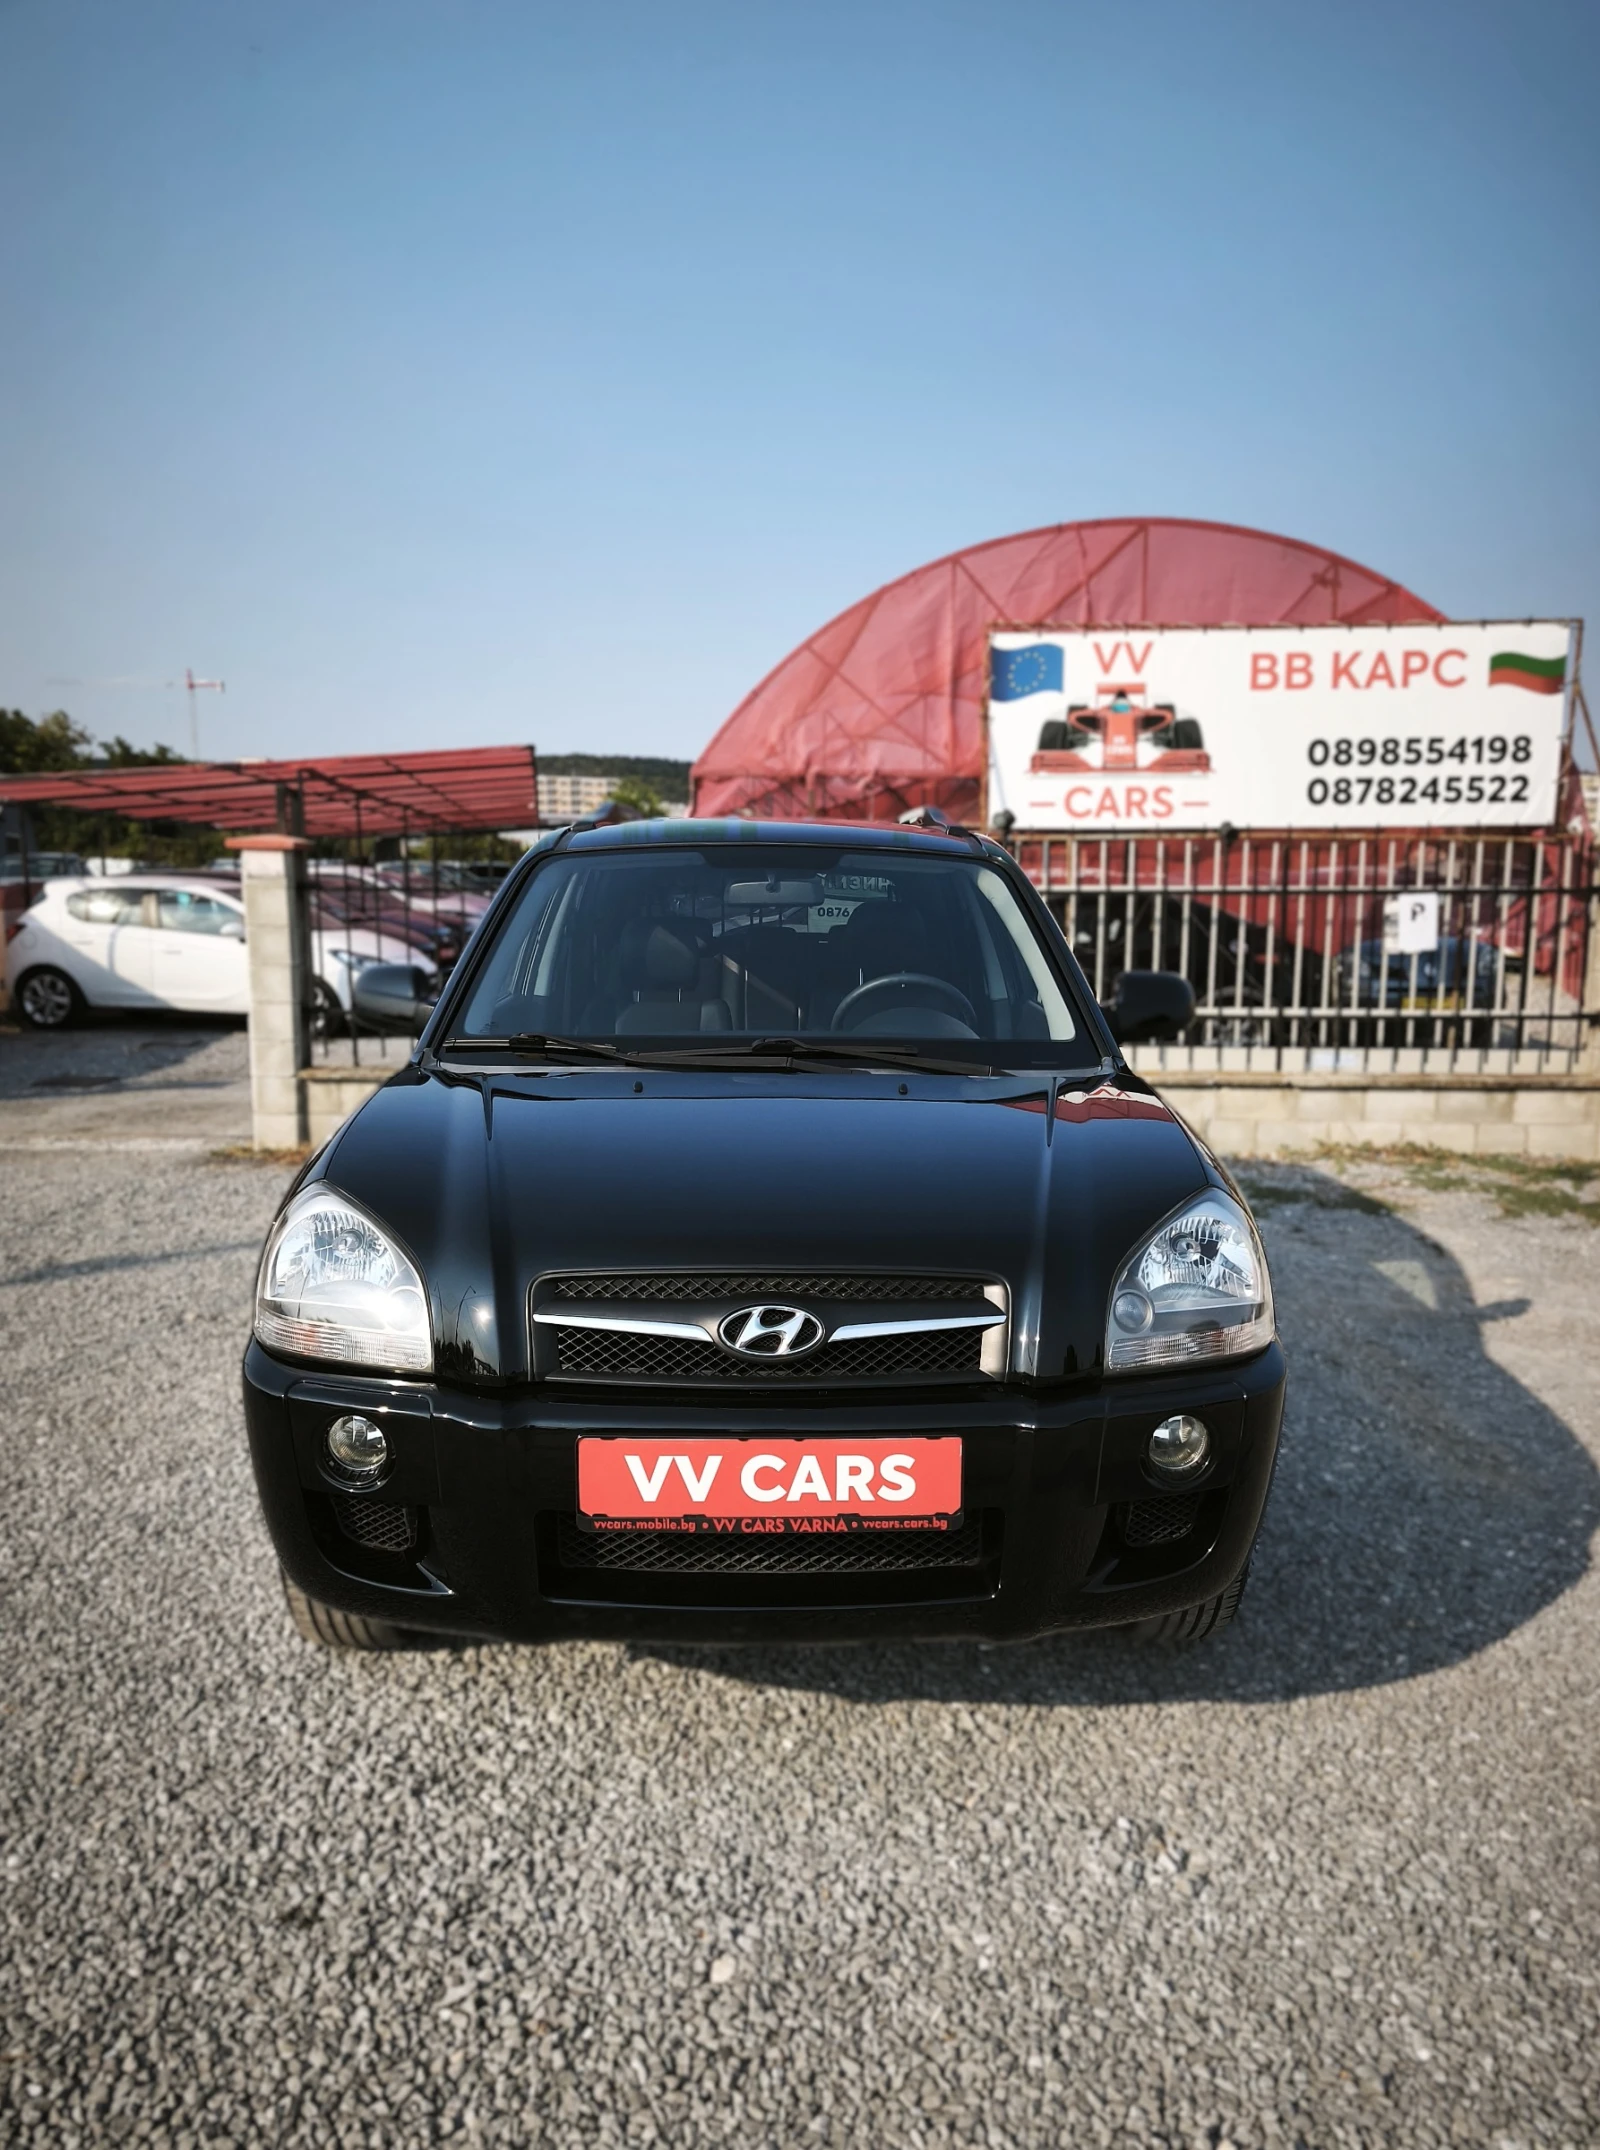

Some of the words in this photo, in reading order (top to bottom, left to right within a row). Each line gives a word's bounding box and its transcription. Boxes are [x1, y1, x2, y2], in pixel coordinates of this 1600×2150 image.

[1094, 642, 1153, 675] VV
[1331, 648, 1467, 690] КАРС
[1308, 736, 1533, 767] 0898554198
[1063, 786, 1174, 820] CARS
[1307, 775, 1530, 806] 0878245522
[624, 1454, 723, 1502] VV
[740, 1453, 916, 1503] CARS
[594, 1519, 696, 1532] vvcars.mobile.bg
[713, 1518, 736, 1533] VV
[740, 1518, 785, 1533] CARS
[789, 1517, 848, 1533] VARNA
[862, 1518, 948, 1531] vvcars.cars.bg
